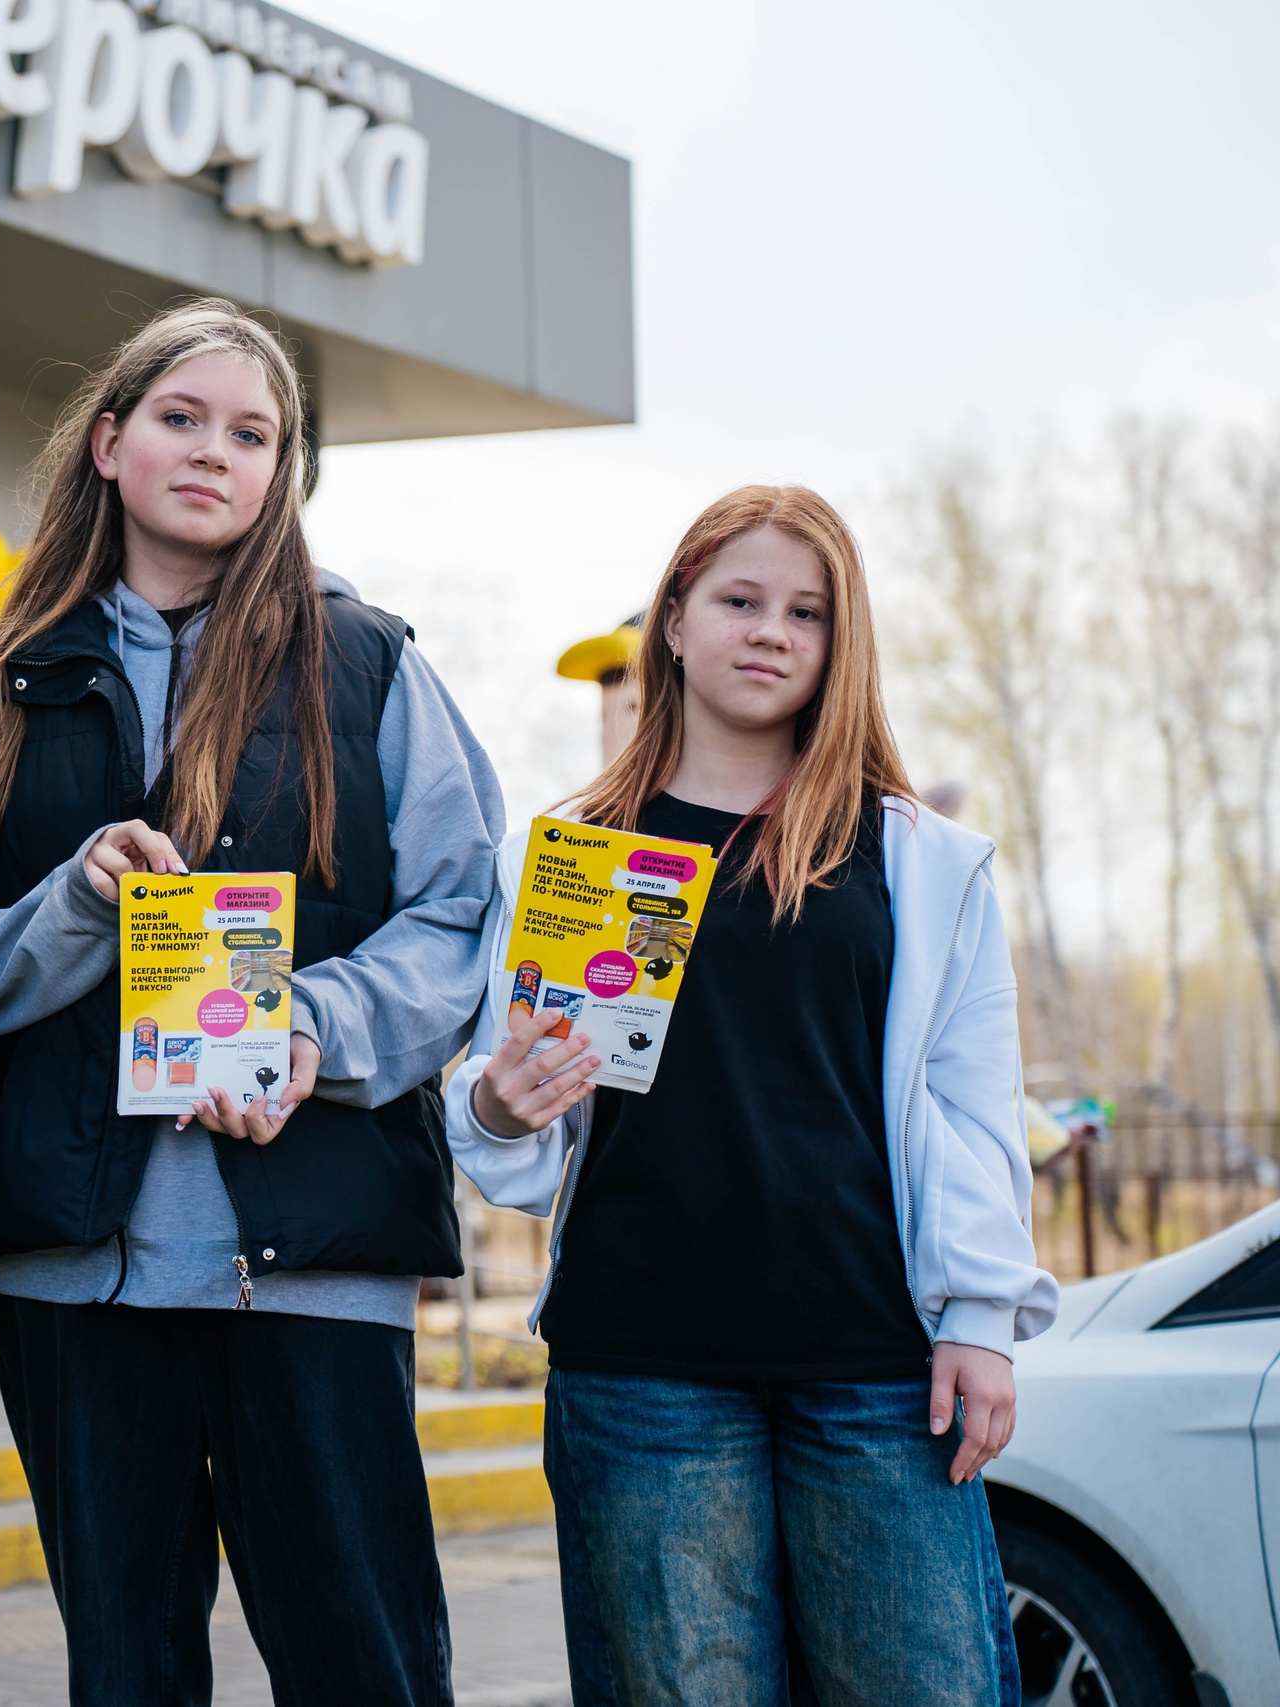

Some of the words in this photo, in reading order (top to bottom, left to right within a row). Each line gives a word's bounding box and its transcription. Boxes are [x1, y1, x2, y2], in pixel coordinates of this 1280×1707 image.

[564, 835, 610, 849] Чижик
[538, 853, 577, 869] НОВЫЙ
[641, 856, 686, 868] ОТКРЫТИЕ
[536, 864, 588, 884] МАГАЗИН,
[640, 864, 684, 877] МАГАЗИНА
[534, 874, 553, 885] ГДЕ
[555, 879, 615, 898] ПОКУПАЮТ
[636, 881, 666, 890] АПРЕЛЯ
[151, 886, 194, 899] Чижик
[532, 884, 603, 907] ПО-УМНОМУ!
[131, 910, 168, 920] НОВЫЙ
[527, 908, 558, 921] ВСЕГДА
[560, 916, 603, 931] ВЫГОДНО
[131, 923, 182, 932] МАГАЗИН,
[525, 917, 585, 936] КАЧЕСТВЕННО
[131, 933, 149, 942] ГДЕ
[152, 932, 209, 940] ПОКУПАЮТ
[531, 927, 565, 941] ВКУСНО
[131, 943, 200, 951] ПО-УМНОМУ!
[164, 967, 205, 975] ВЫГОДНО
